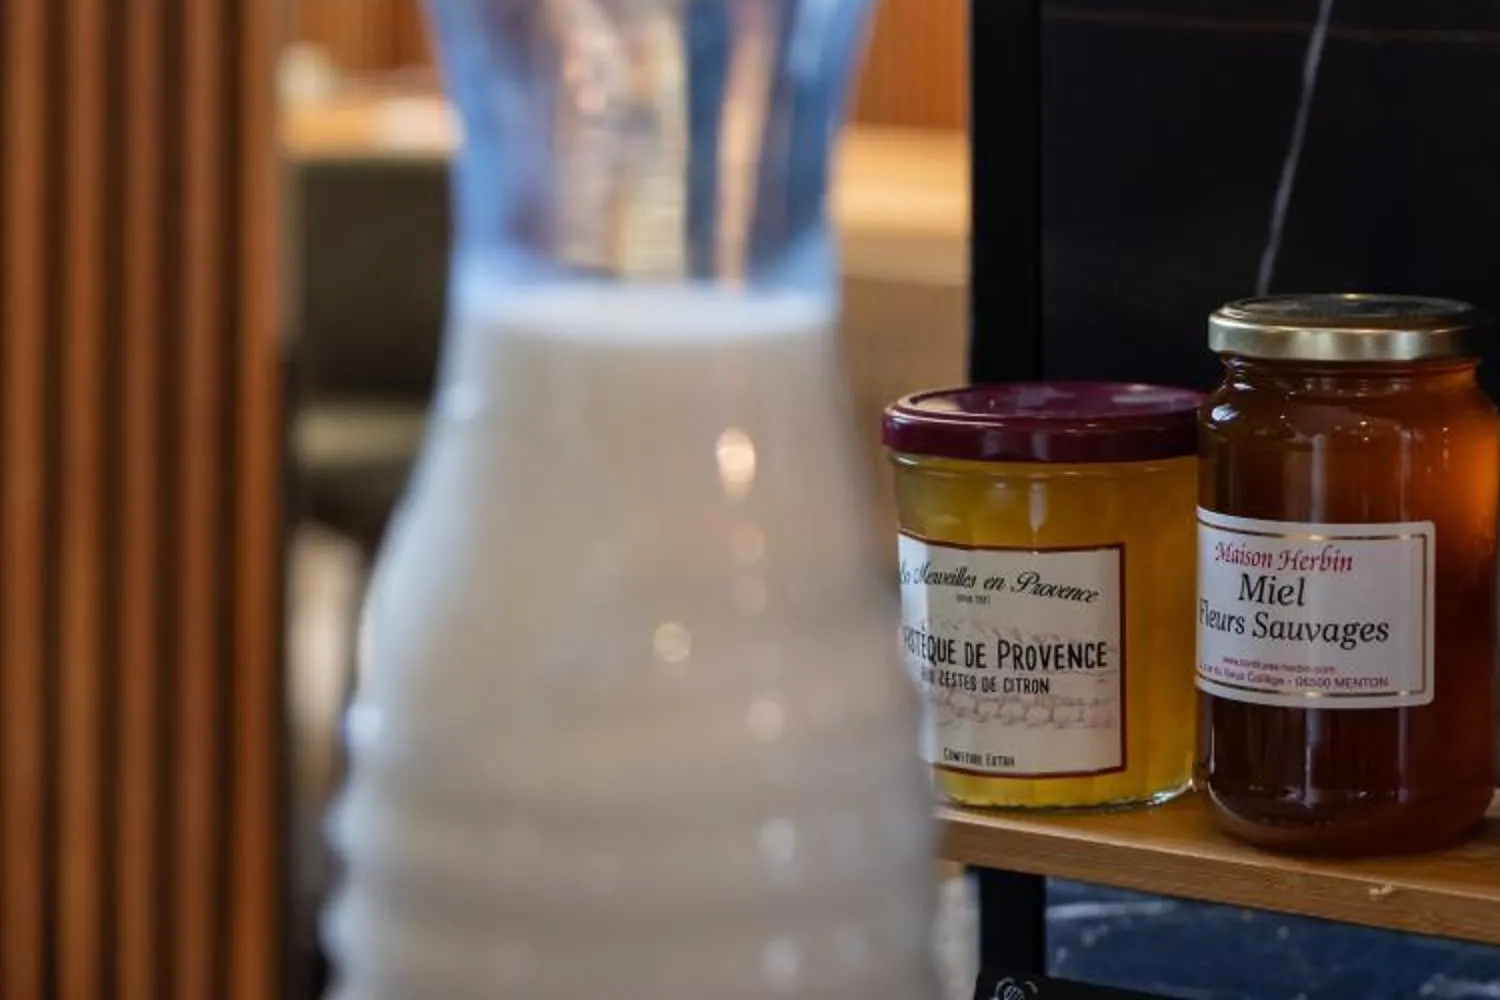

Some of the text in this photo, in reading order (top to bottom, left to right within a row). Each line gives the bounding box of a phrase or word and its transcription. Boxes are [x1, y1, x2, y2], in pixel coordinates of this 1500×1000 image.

[1215, 541, 1353, 573] Maison Herbin
[983, 576, 1006, 592] en
[1010, 571, 1100, 604] Provence
[1238, 573, 1306, 607] Miel
[1252, 610, 1390, 651] Sauvages
[964, 641, 987, 669] DE
[997, 640, 1108, 672] PROVENCE
[1003, 677, 1051, 695] CITRON
[1333, 677, 1390, 690] MENTON
